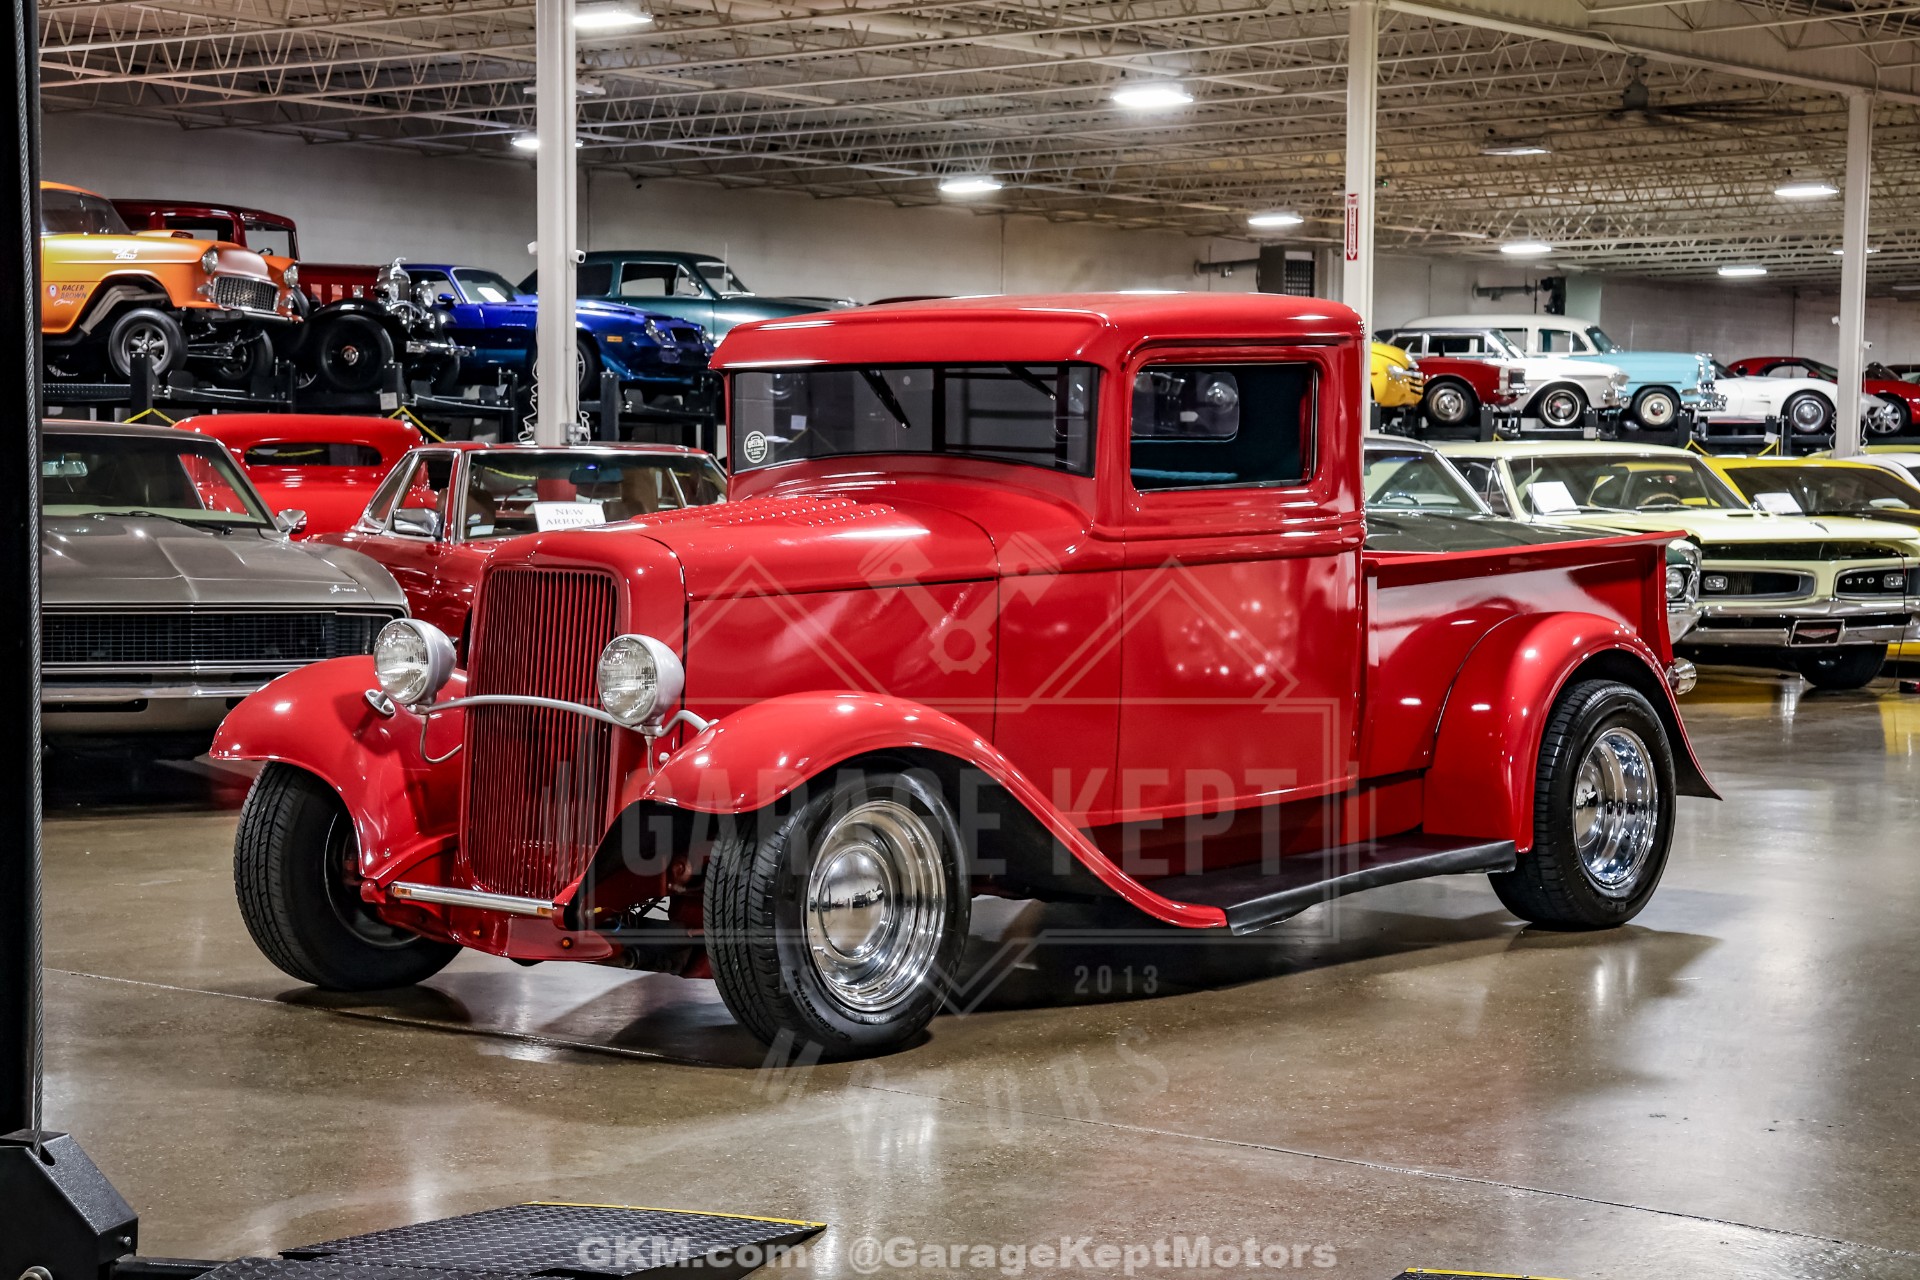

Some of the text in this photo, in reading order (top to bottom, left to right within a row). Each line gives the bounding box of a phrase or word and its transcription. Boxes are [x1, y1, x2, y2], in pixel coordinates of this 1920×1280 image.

[61, 284, 85, 292] RACER
[60, 292, 87, 300] BROWN
[555, 508, 584, 516] NEW
[545, 518, 596, 526] ARRIVAL
[1845, 577, 1875, 585] GTO
